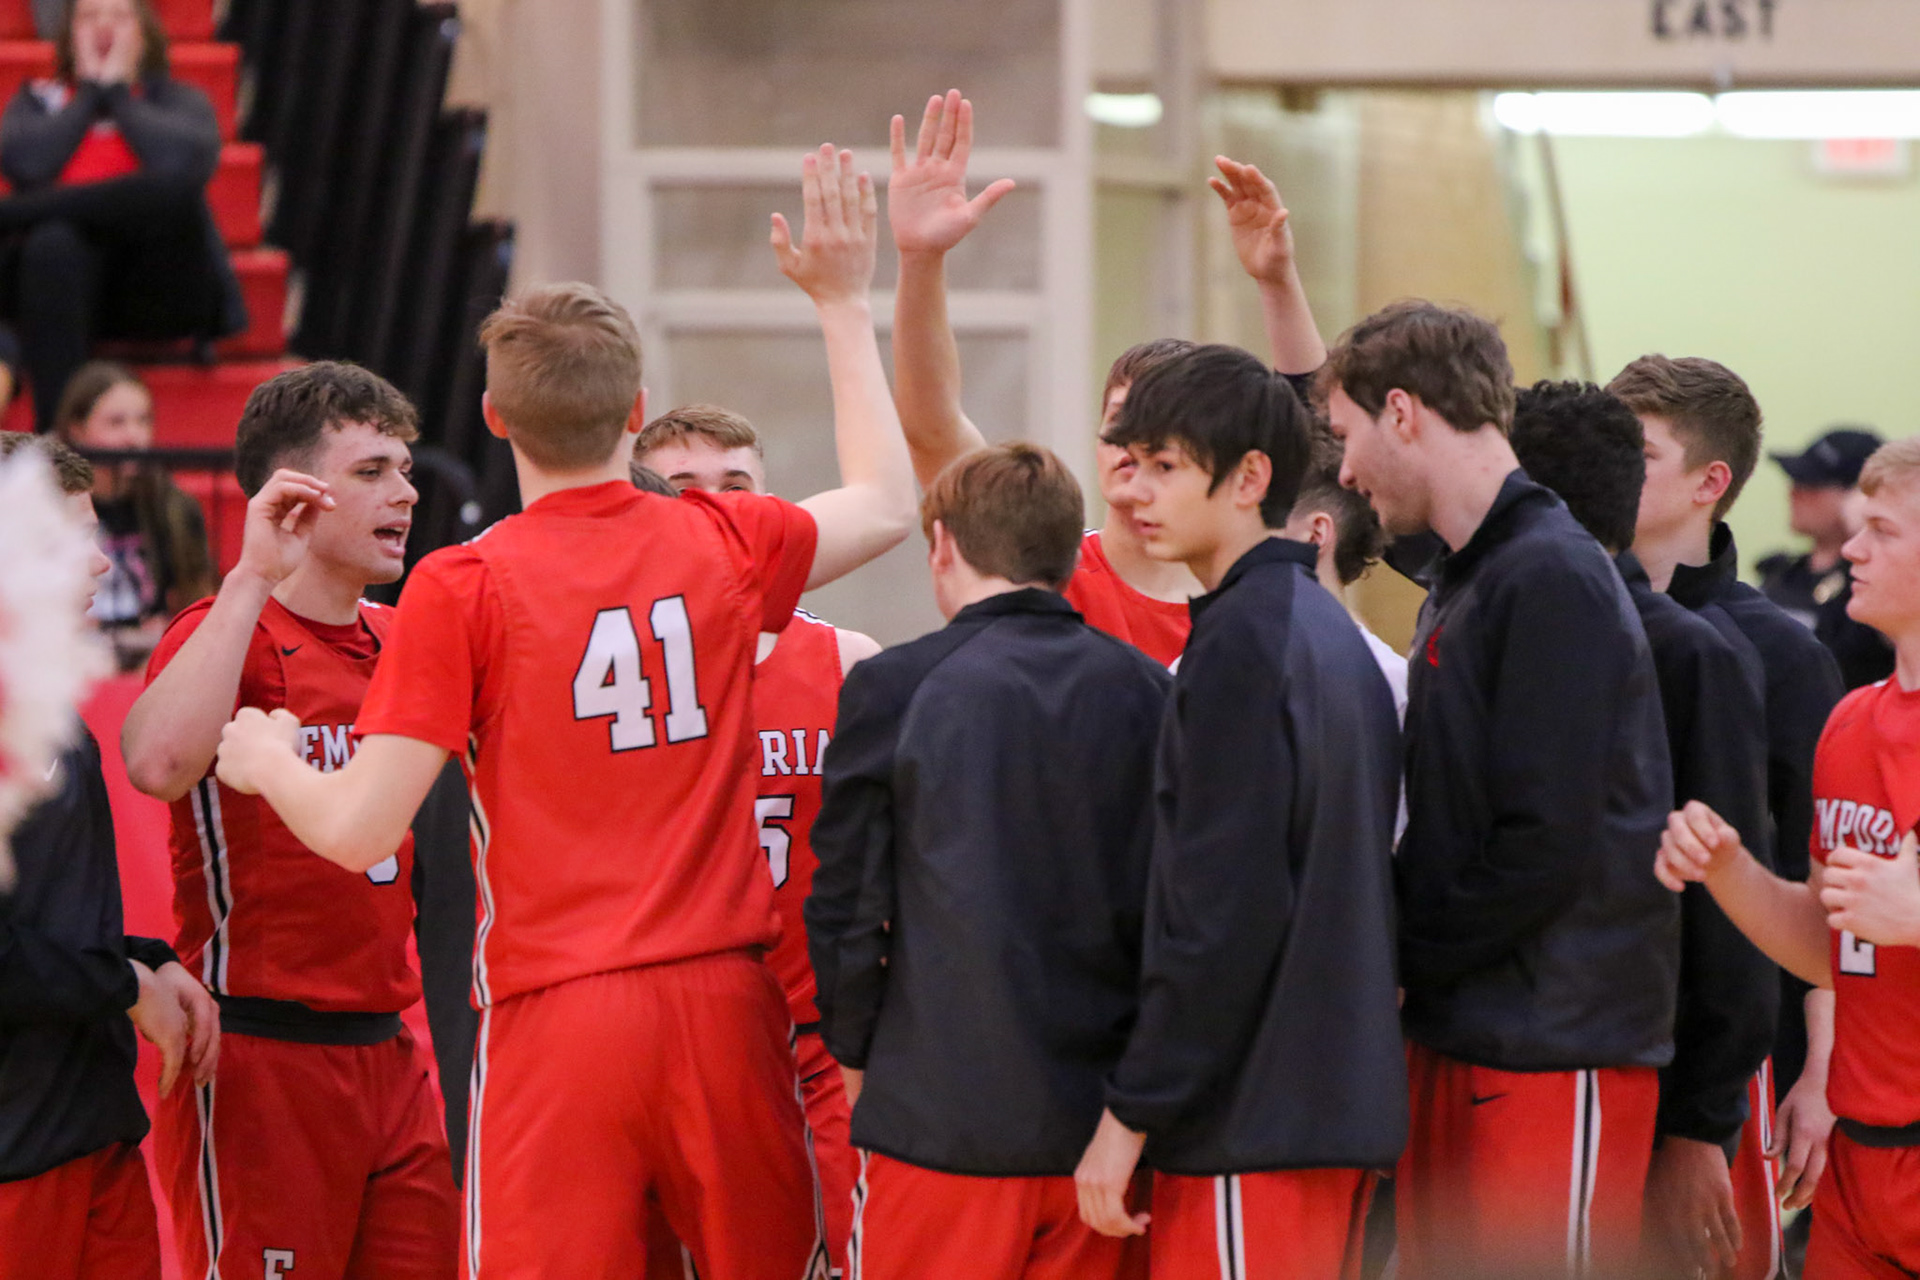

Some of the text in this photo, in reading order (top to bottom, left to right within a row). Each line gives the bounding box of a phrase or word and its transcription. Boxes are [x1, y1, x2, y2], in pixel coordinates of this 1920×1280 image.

[1650, 0, 1774, 41] EAST
[572, 593, 709, 753] 41
[299, 724, 360, 774] EM
[1816, 798, 1901, 855] MPOR
